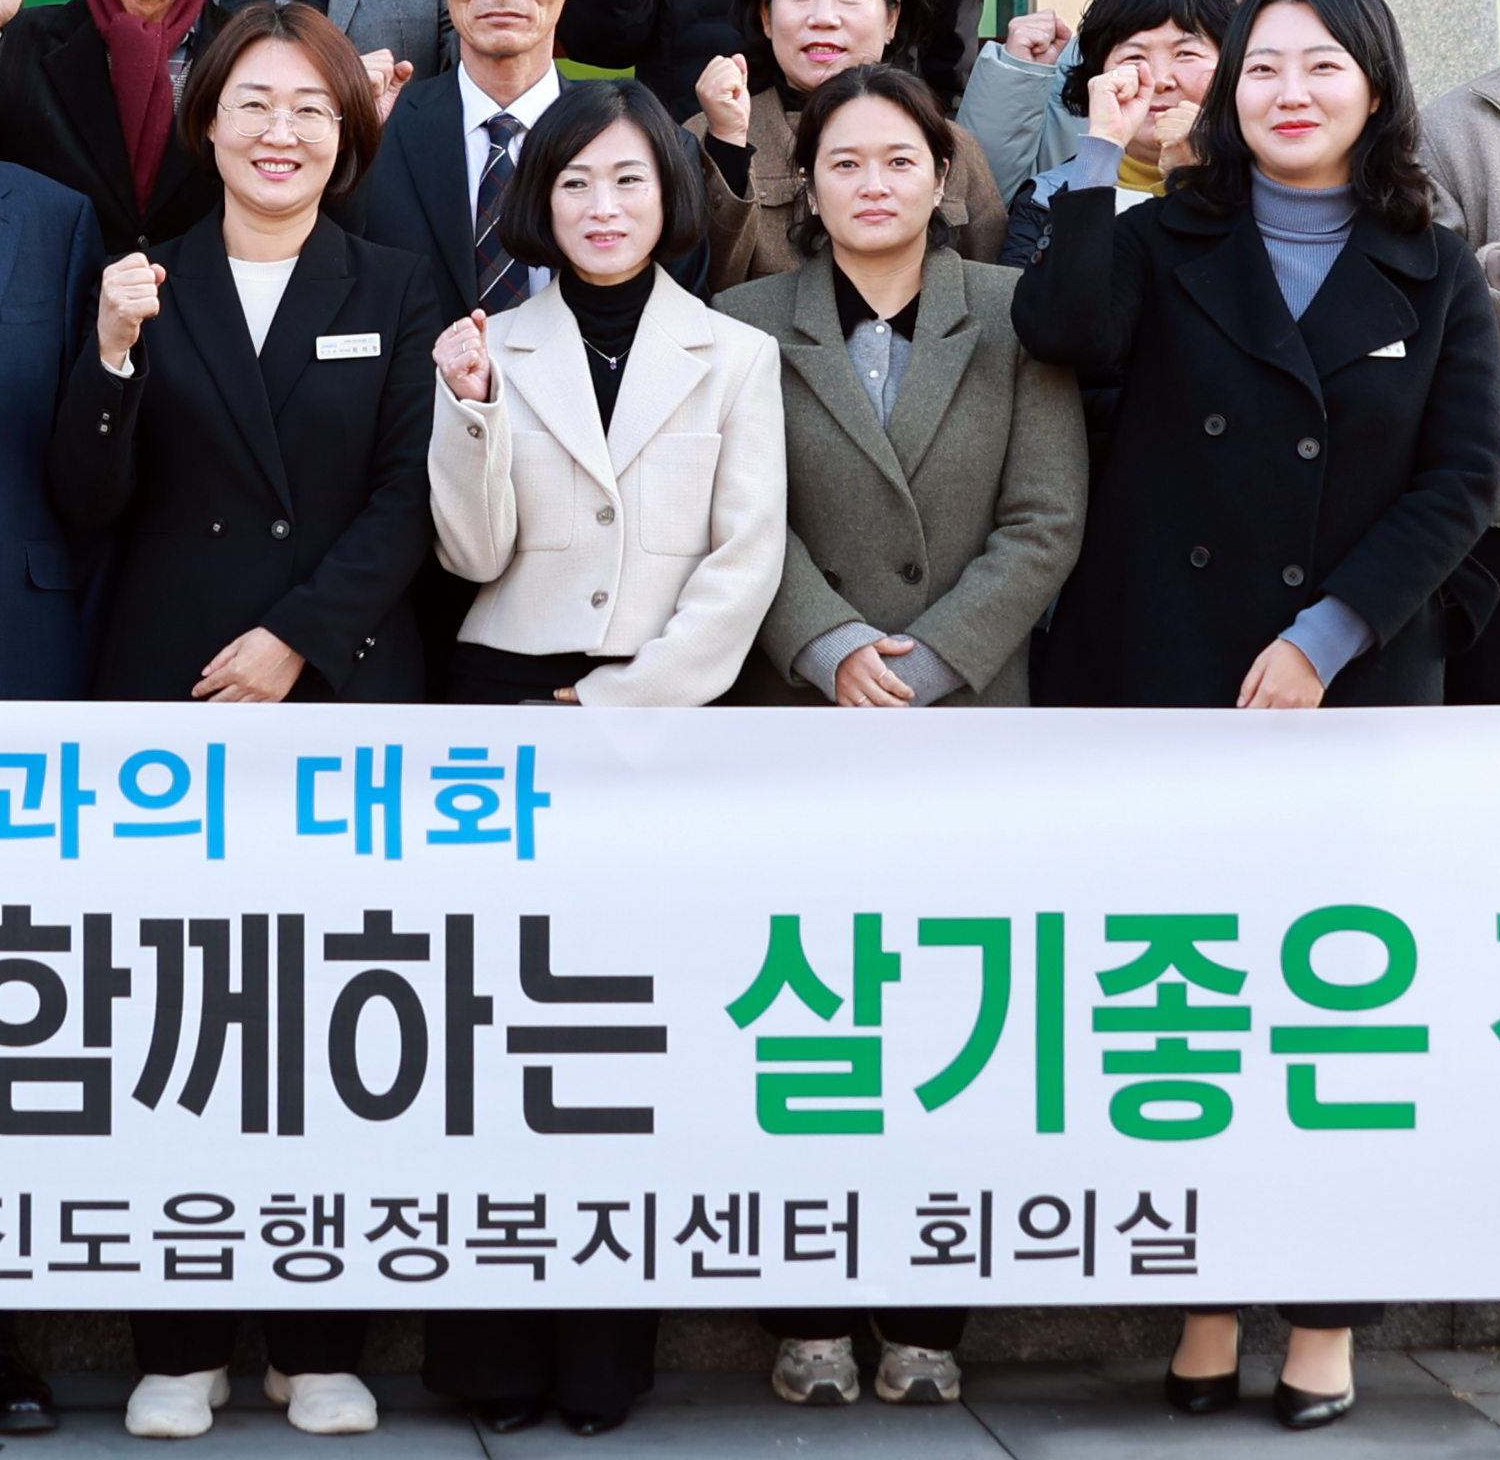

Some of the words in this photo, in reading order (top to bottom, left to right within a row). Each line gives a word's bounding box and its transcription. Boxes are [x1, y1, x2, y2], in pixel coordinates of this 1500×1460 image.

[297, 743, 551, 860] 대화
[725, 903, 1430, 1142] 살기좋은
[909, 1189, 1201, 1279] 회의실
